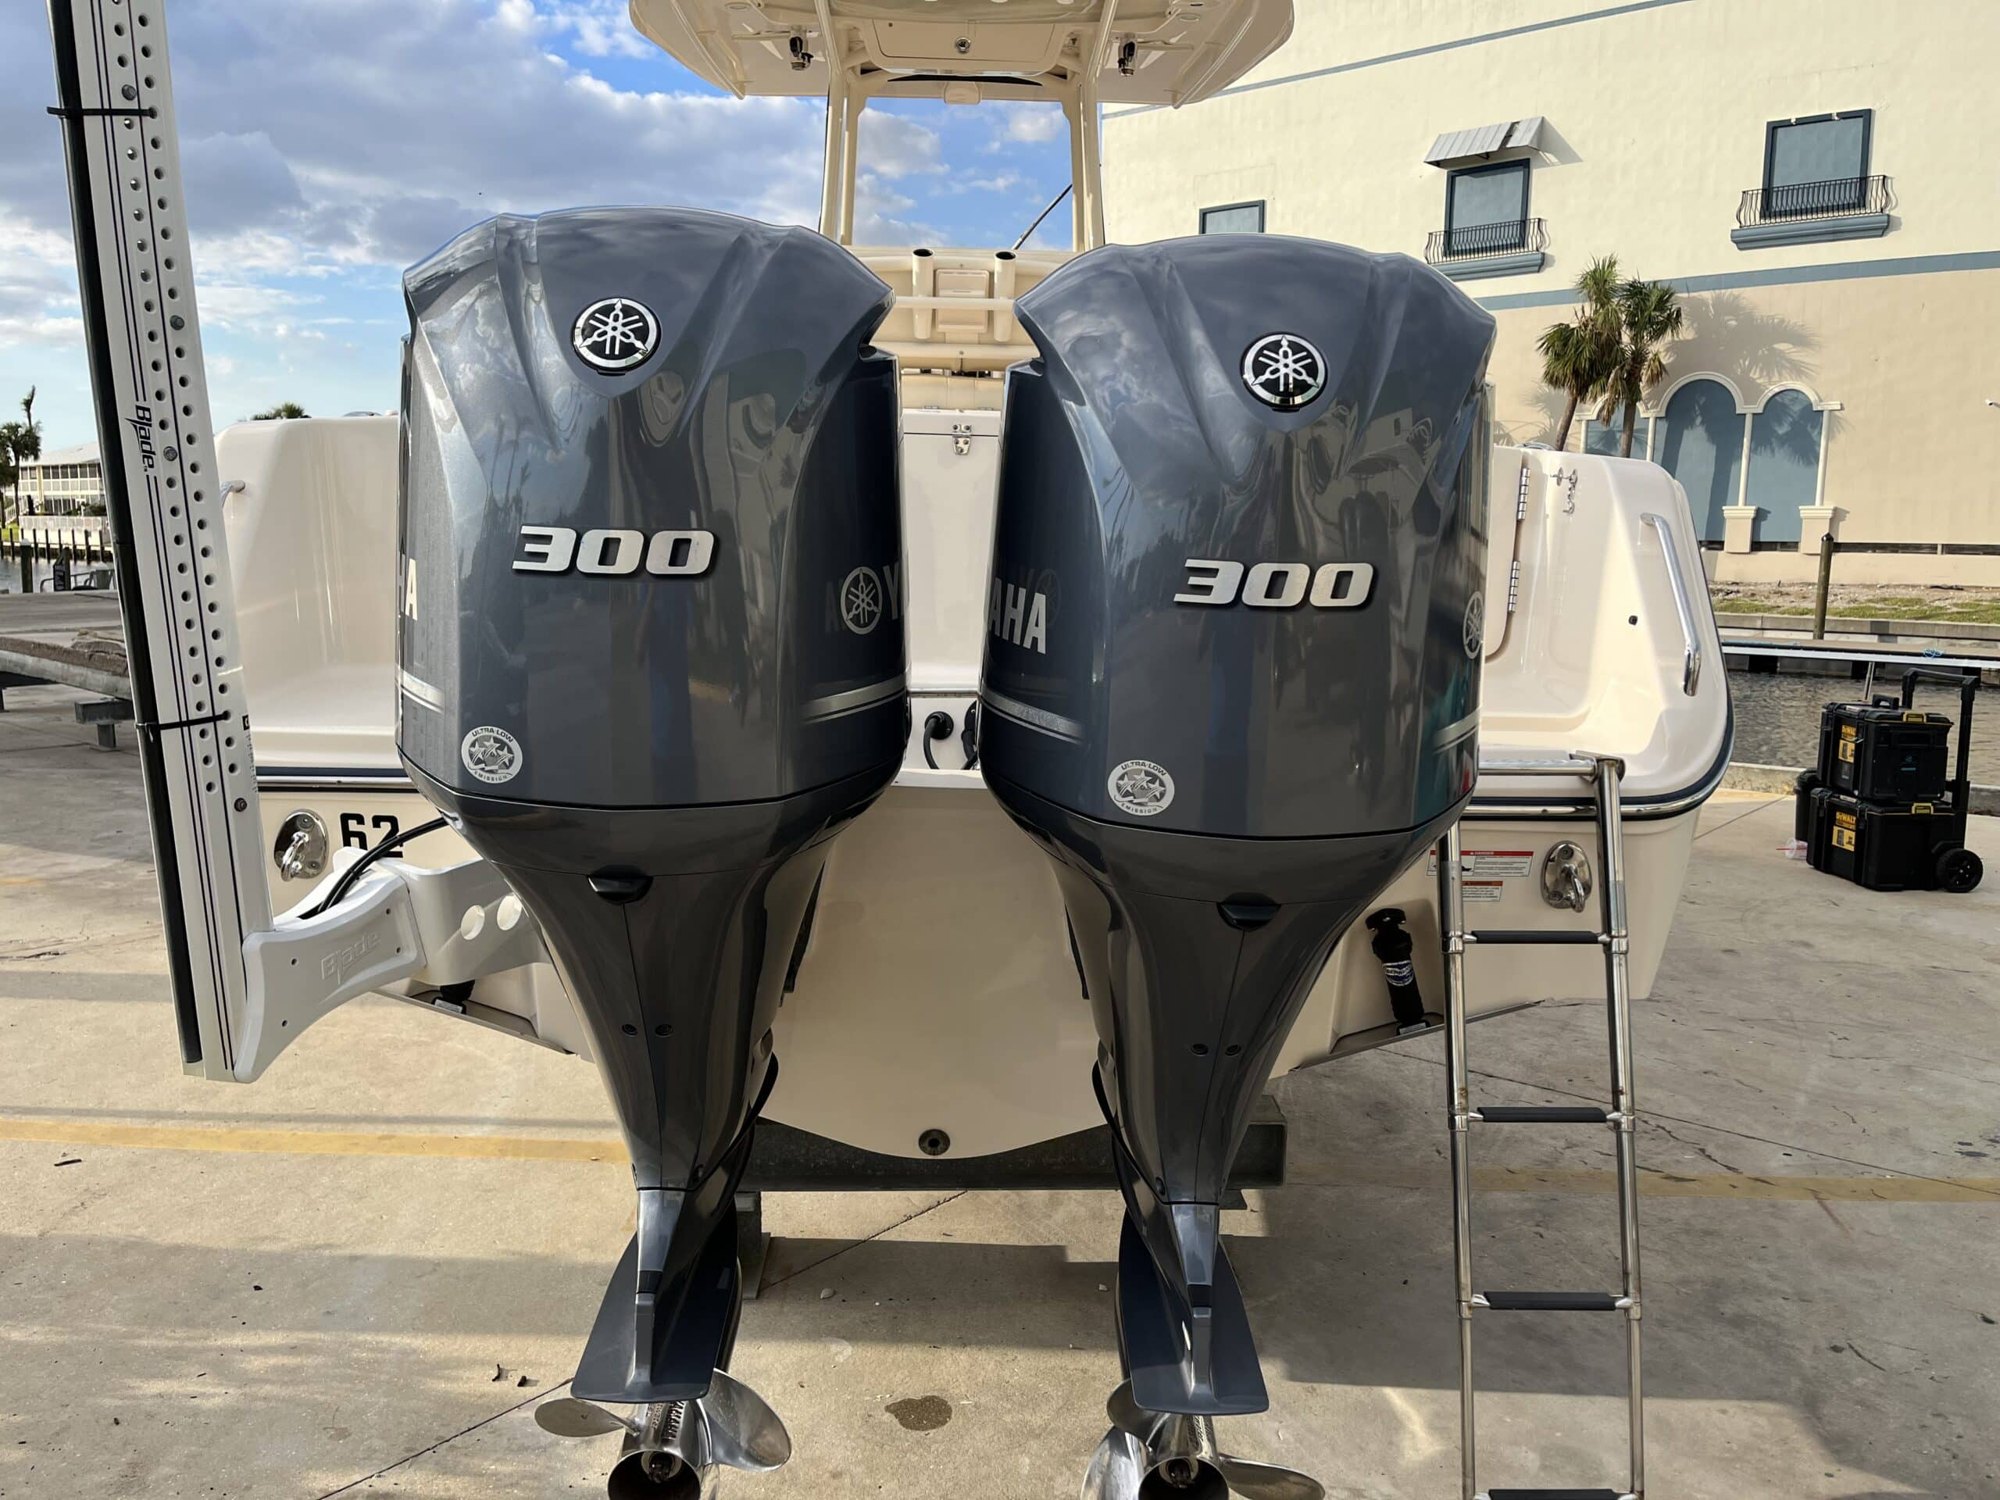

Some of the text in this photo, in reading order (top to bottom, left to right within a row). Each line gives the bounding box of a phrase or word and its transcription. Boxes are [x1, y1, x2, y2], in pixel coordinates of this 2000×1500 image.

[124, 404, 157, 469] Blade
[512, 525, 715, 575] 300
[1173, 558, 1374, 607] 300
[471, 727, 514, 743] ULTRA LOW
[1120, 761, 1168, 776] ULTRA LOW
[1121, 802, 1158, 814] EMISSION
[340, 812, 404, 858] 62
